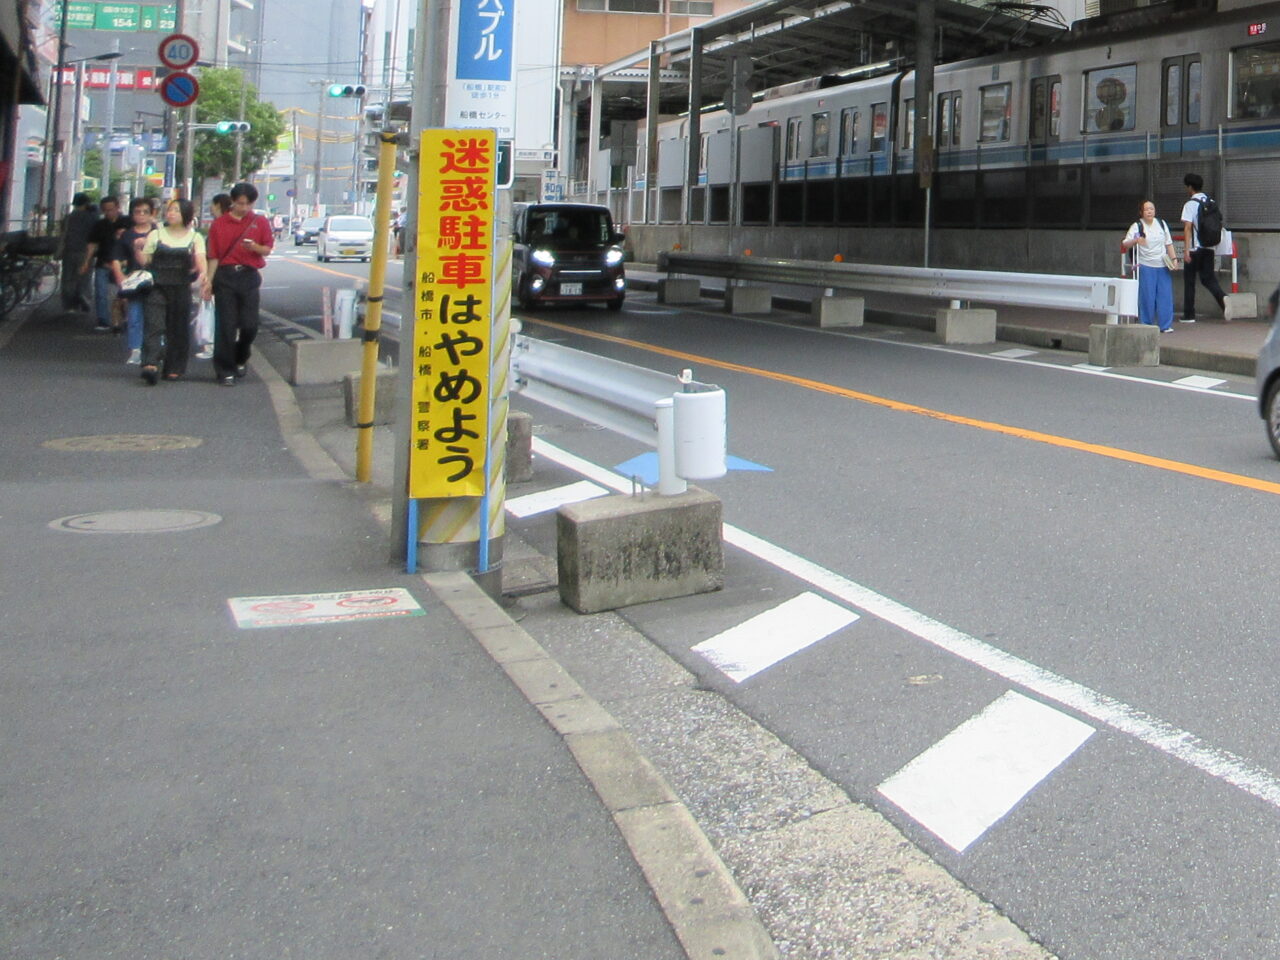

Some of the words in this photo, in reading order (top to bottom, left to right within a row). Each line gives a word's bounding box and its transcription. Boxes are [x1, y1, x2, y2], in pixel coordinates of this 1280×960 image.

[167, 43, 190, 60] 40
[433, 138, 490, 483] 迷惑駐車はやめよう
